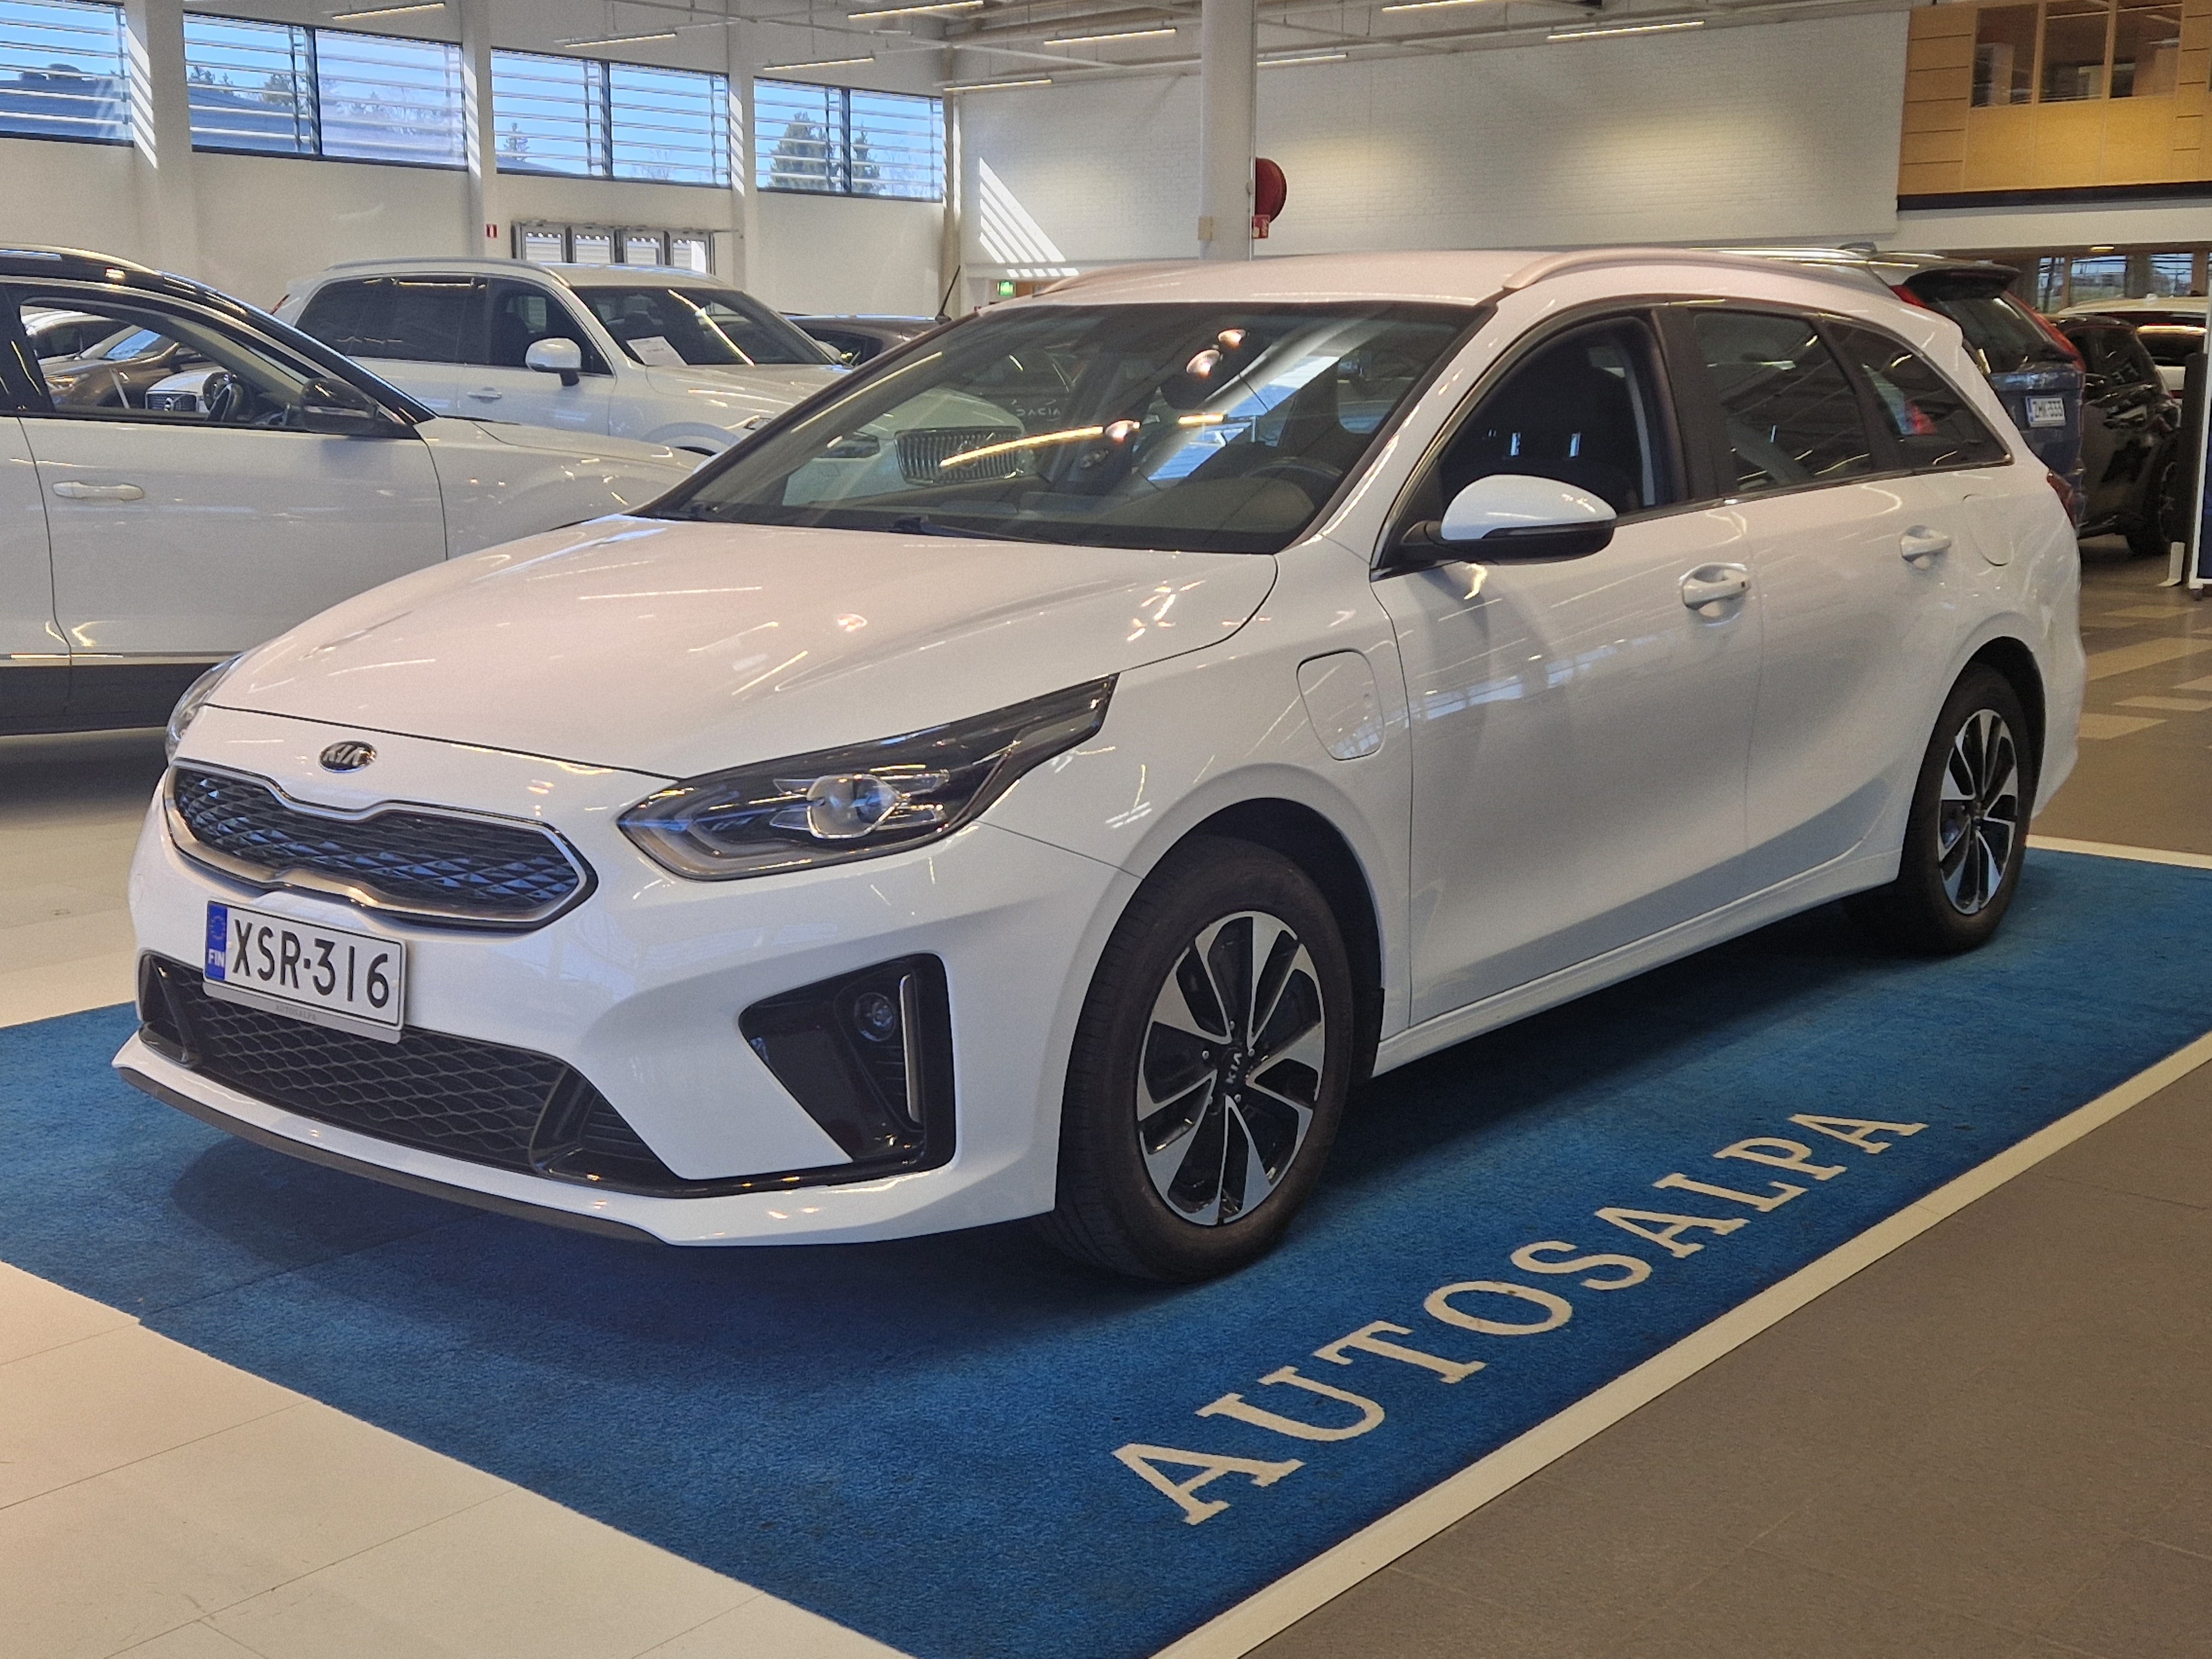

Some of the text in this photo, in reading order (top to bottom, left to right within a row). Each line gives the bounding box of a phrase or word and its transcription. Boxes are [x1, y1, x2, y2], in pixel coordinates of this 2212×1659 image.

[322, 743, 367, 768] KIA
[208, 948, 225, 968] FIN
[232, 919, 389, 1009] XSR-316
[1225, 1052, 1242, 1084] KIA
[1112, 1113, 1928, 1525] AUTOSALPA
